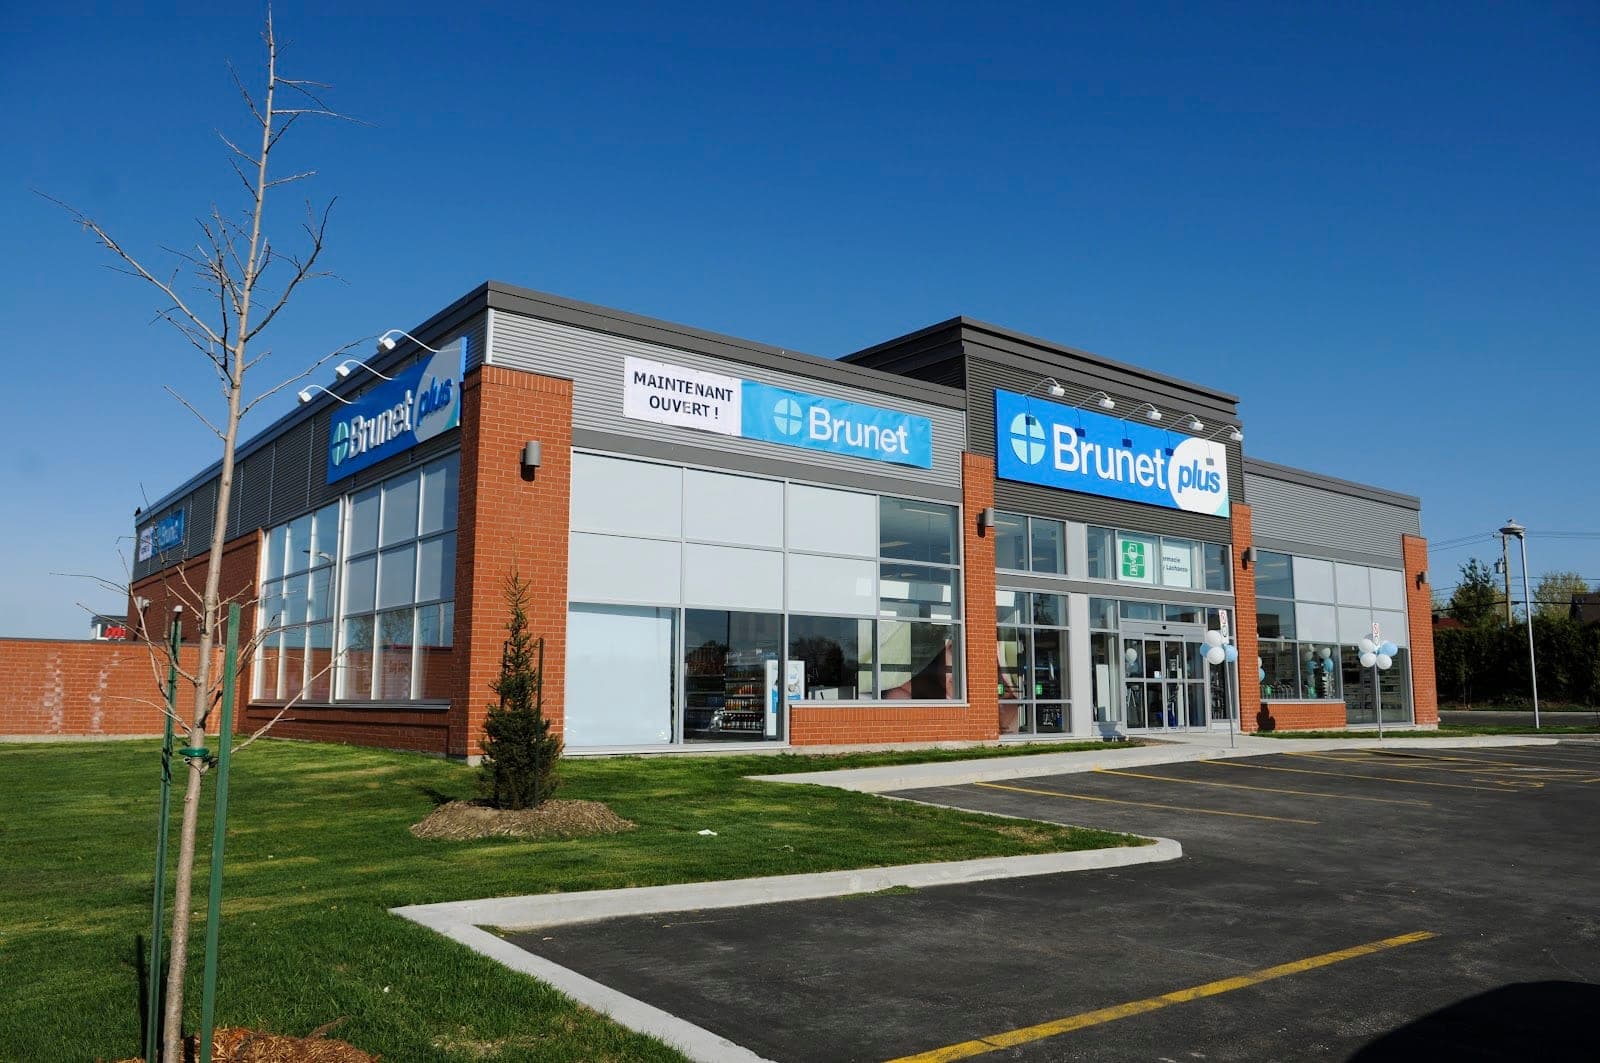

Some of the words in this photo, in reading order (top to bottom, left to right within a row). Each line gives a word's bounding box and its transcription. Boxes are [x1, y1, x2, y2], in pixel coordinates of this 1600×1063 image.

[634, 371, 733, 402] MAINTENANT
[649, 395, 710, 417] OUVERT
[349, 389, 413, 459] Brunet
[417, 377, 453, 427] plus
[809, 406, 909, 454] Brunet
[1053, 423, 1167, 490] Brunet
[1178, 459, 1220, 494] plus
